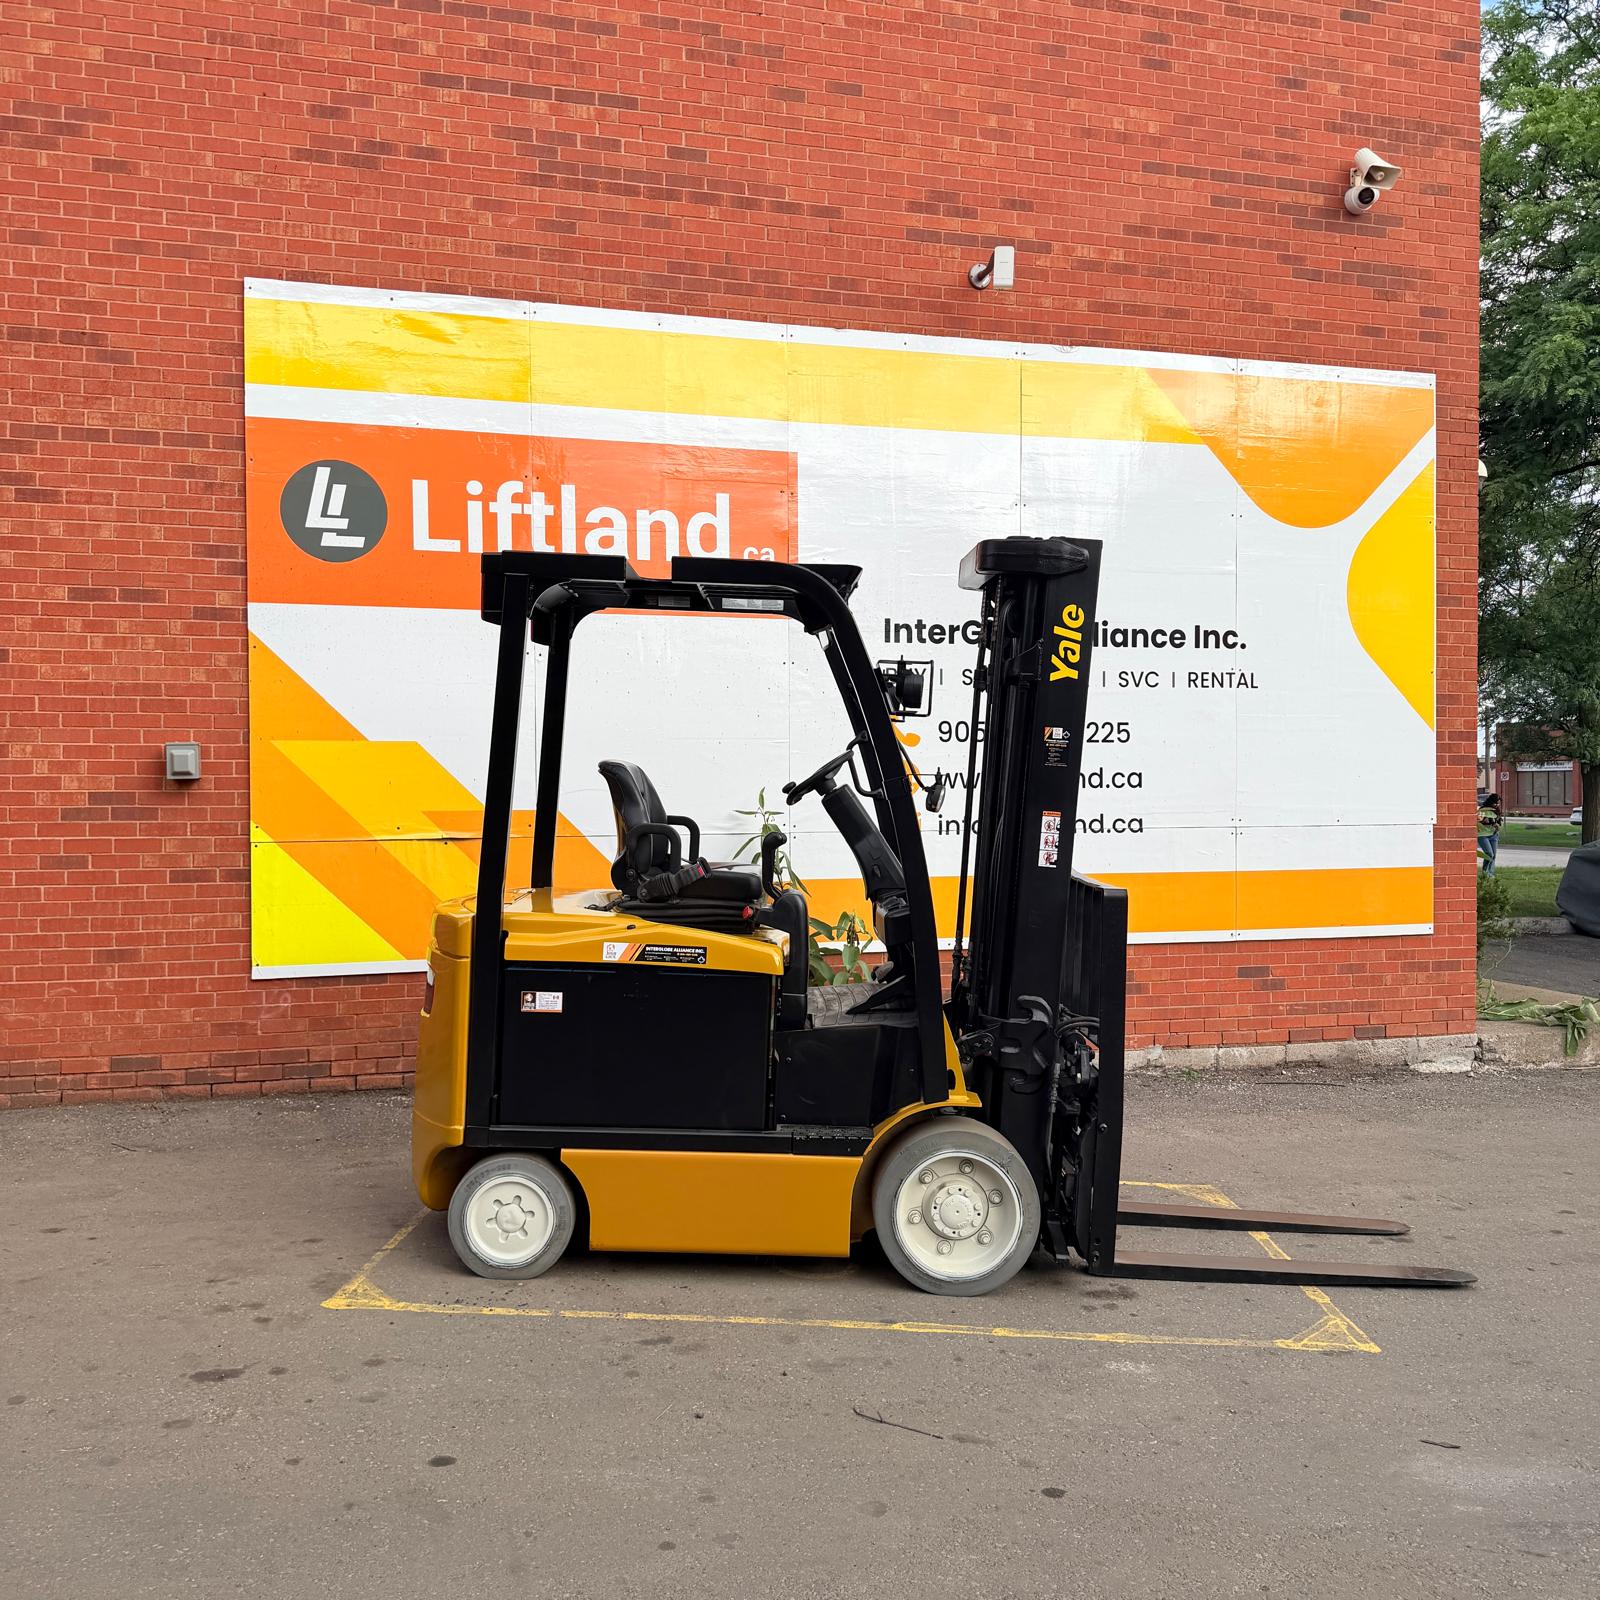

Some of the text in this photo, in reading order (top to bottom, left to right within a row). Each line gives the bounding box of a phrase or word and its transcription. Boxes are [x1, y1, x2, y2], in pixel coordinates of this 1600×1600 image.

[412, 479, 730, 561] Liftland
[884, 618, 1247, 649] InterG liance Inc.
[1049, 604, 1085, 682] Yale
[1118, 671, 1259, 689] SVC RENTAL
[1086, 721, 1131, 743] 225
